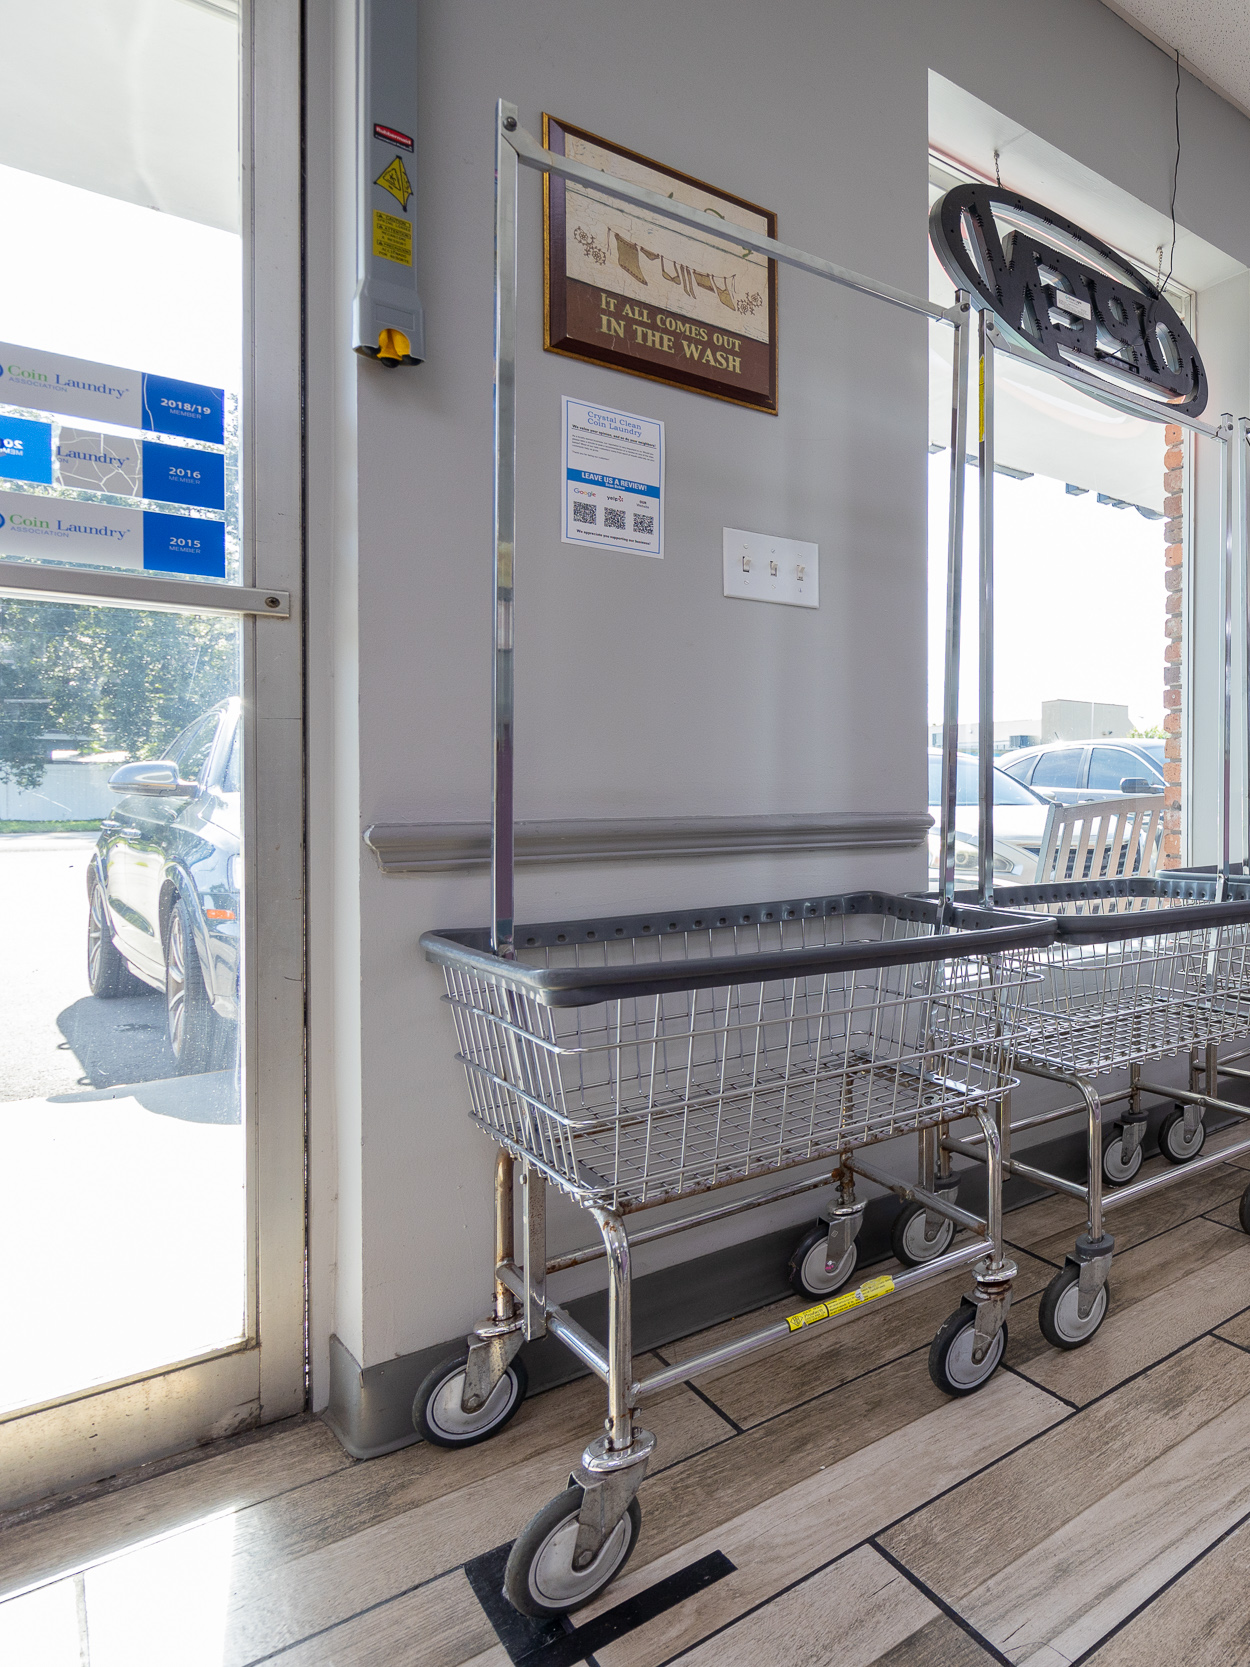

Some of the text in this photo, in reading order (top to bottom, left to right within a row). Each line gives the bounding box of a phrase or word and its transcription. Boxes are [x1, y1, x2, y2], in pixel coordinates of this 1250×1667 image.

[375, 126, 412, 146] Rubbermaid
[600, 292, 742, 352] IT ALL COMES OUT
[600, 314, 742, 374] IN THE WASH
[7, 364, 125, 400] Coin Laundry
[8, 376, 68, 392] ASSOCIATION
[160, 398, 211, 415] 2018/19
[169, 408, 202, 420] MEMBER
[587, 410, 642, 430] Crystal Clean
[587, 417, 642, 438] Coin Laundry
[57, 445, 126, 468] Laundry
[168, 466, 201, 478] 2016
[168, 475, 201, 485] MEMBER
[581, 471, 603, 482] LEAVE
[614, 478, 620, 486] A
[620, 480, 648, 491] REVIEW!
[573, 487, 597, 497] Google
[9, 513, 126, 540] Coin Laundry
[10, 526, 69, 538] ASSOCIATION
[168, 545, 201, 554] MEMBER
[169, 536, 201, 548] 2015
